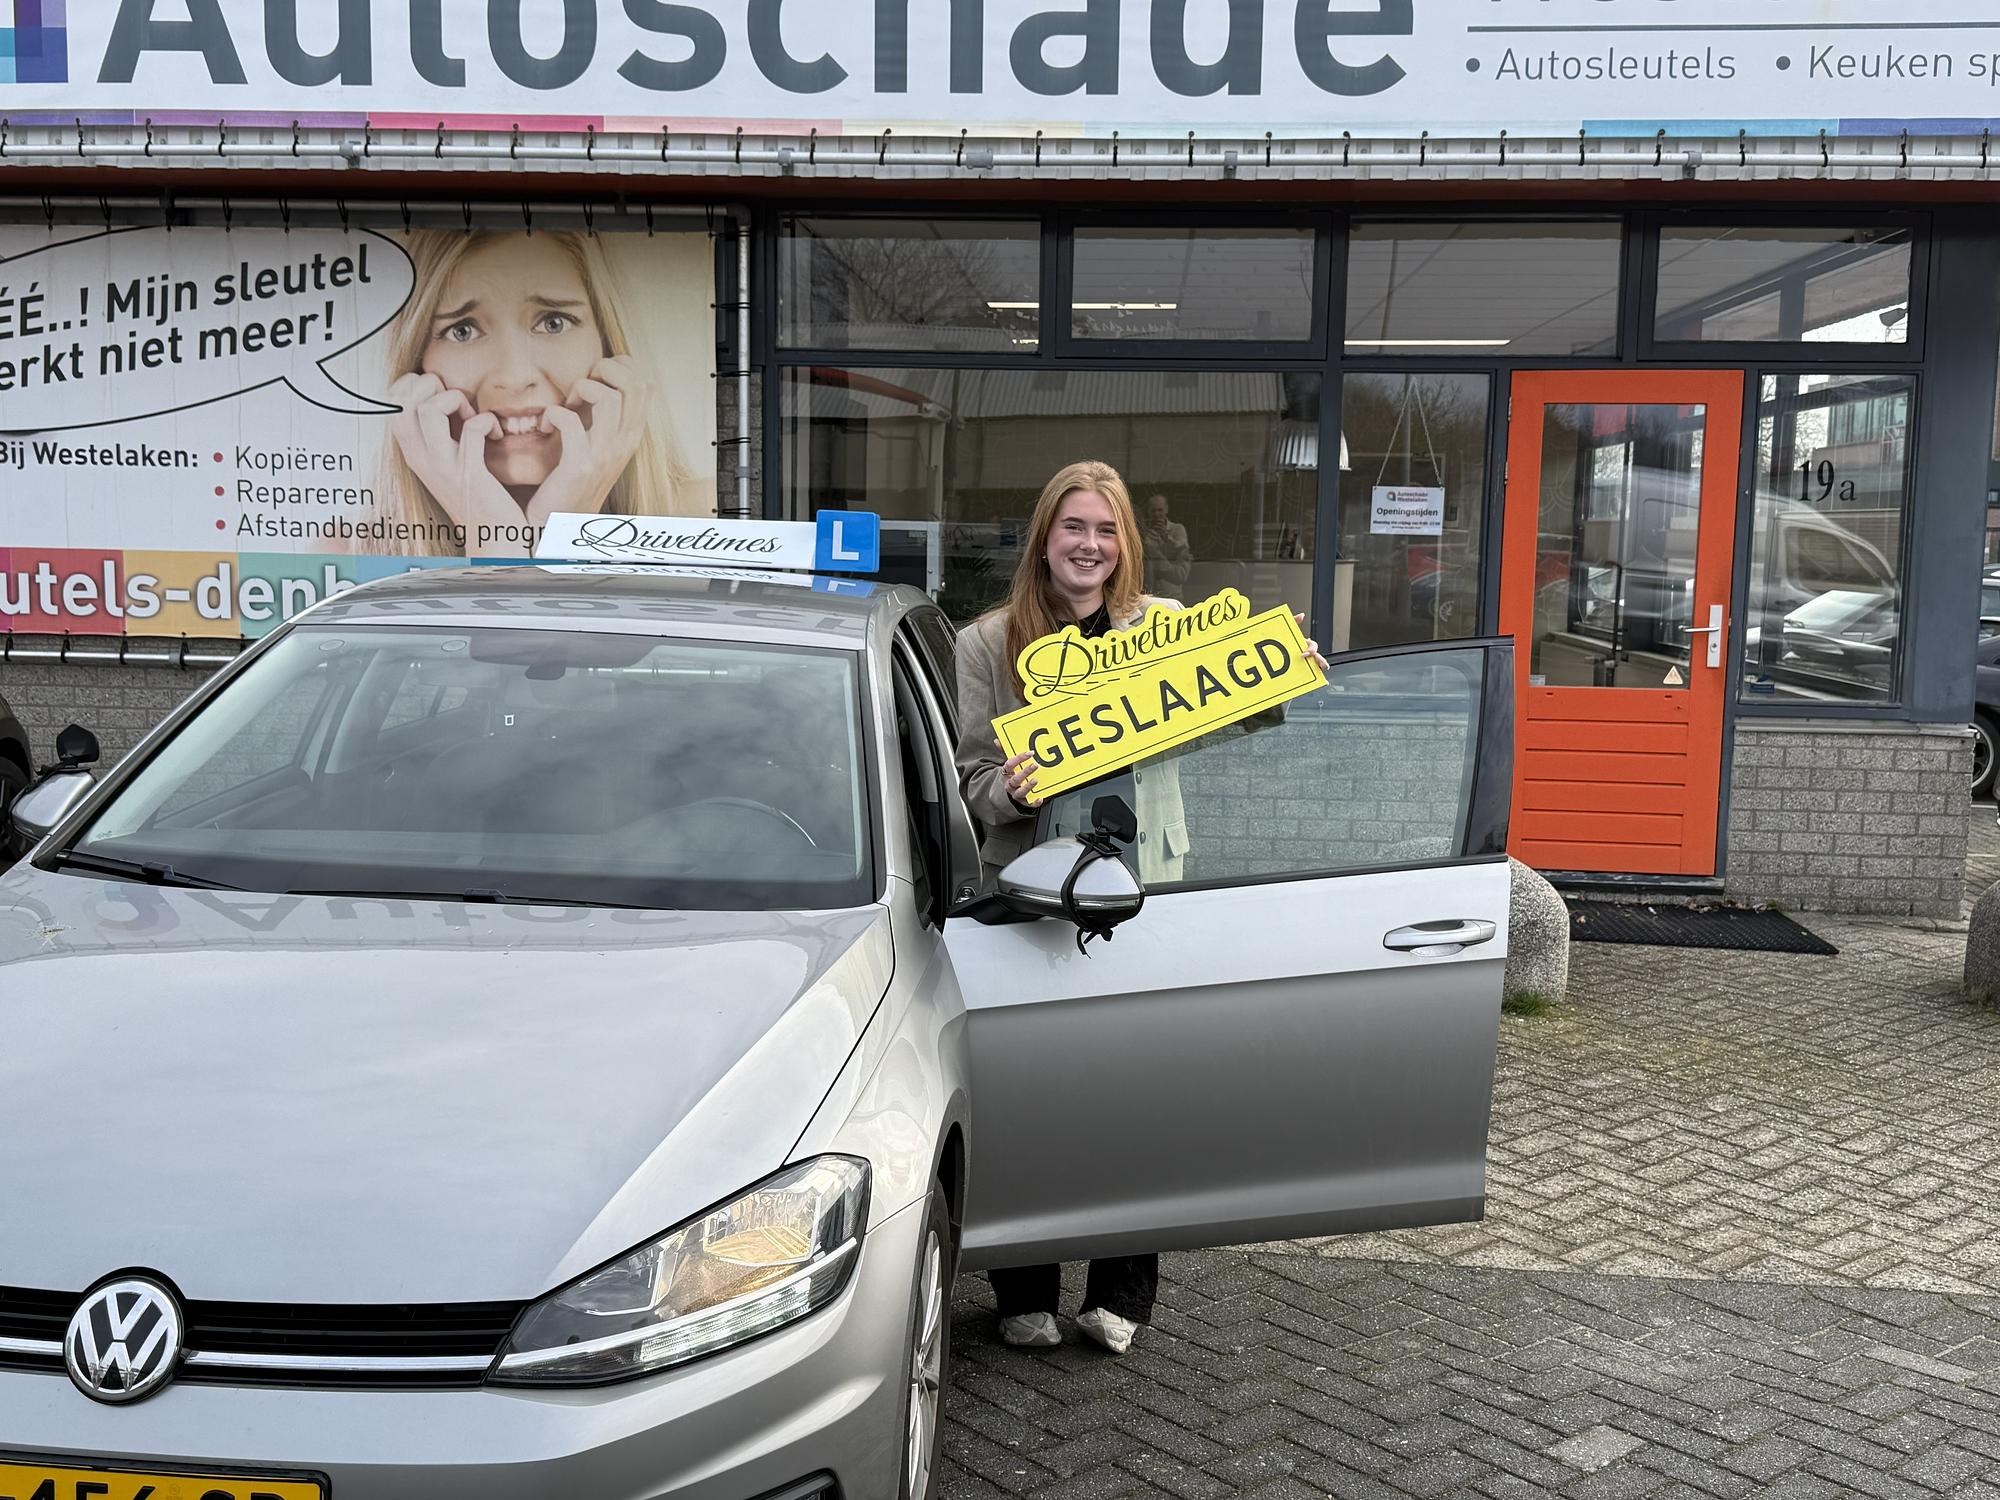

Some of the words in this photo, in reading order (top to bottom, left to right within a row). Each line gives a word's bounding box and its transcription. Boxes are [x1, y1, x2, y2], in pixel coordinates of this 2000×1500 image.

[1495, 46, 1737, 81] Autosleutels
[1809, 45, 1953, 79] Keuken
[106, 273, 198, 327] Mijn
[213, 243, 372, 306] sleutel
[99, 326, 183, 376] niet
[198, 300, 335, 361] meer!
[32, 441, 199, 468] Westelaken:
[235, 446, 353, 476] Kopiëren
[236, 480, 374, 509] Repareren
[1376, 507, 1438, 517] Openingstijden
[236, 513, 467, 548] Afstandbediening
[571, 517, 783, 555] Drivetimes
[832, 520, 860, 561] L
[1025, 594, 1242, 698] Drivetimes
[1027, 638, 1291, 769] GESLAAGD
